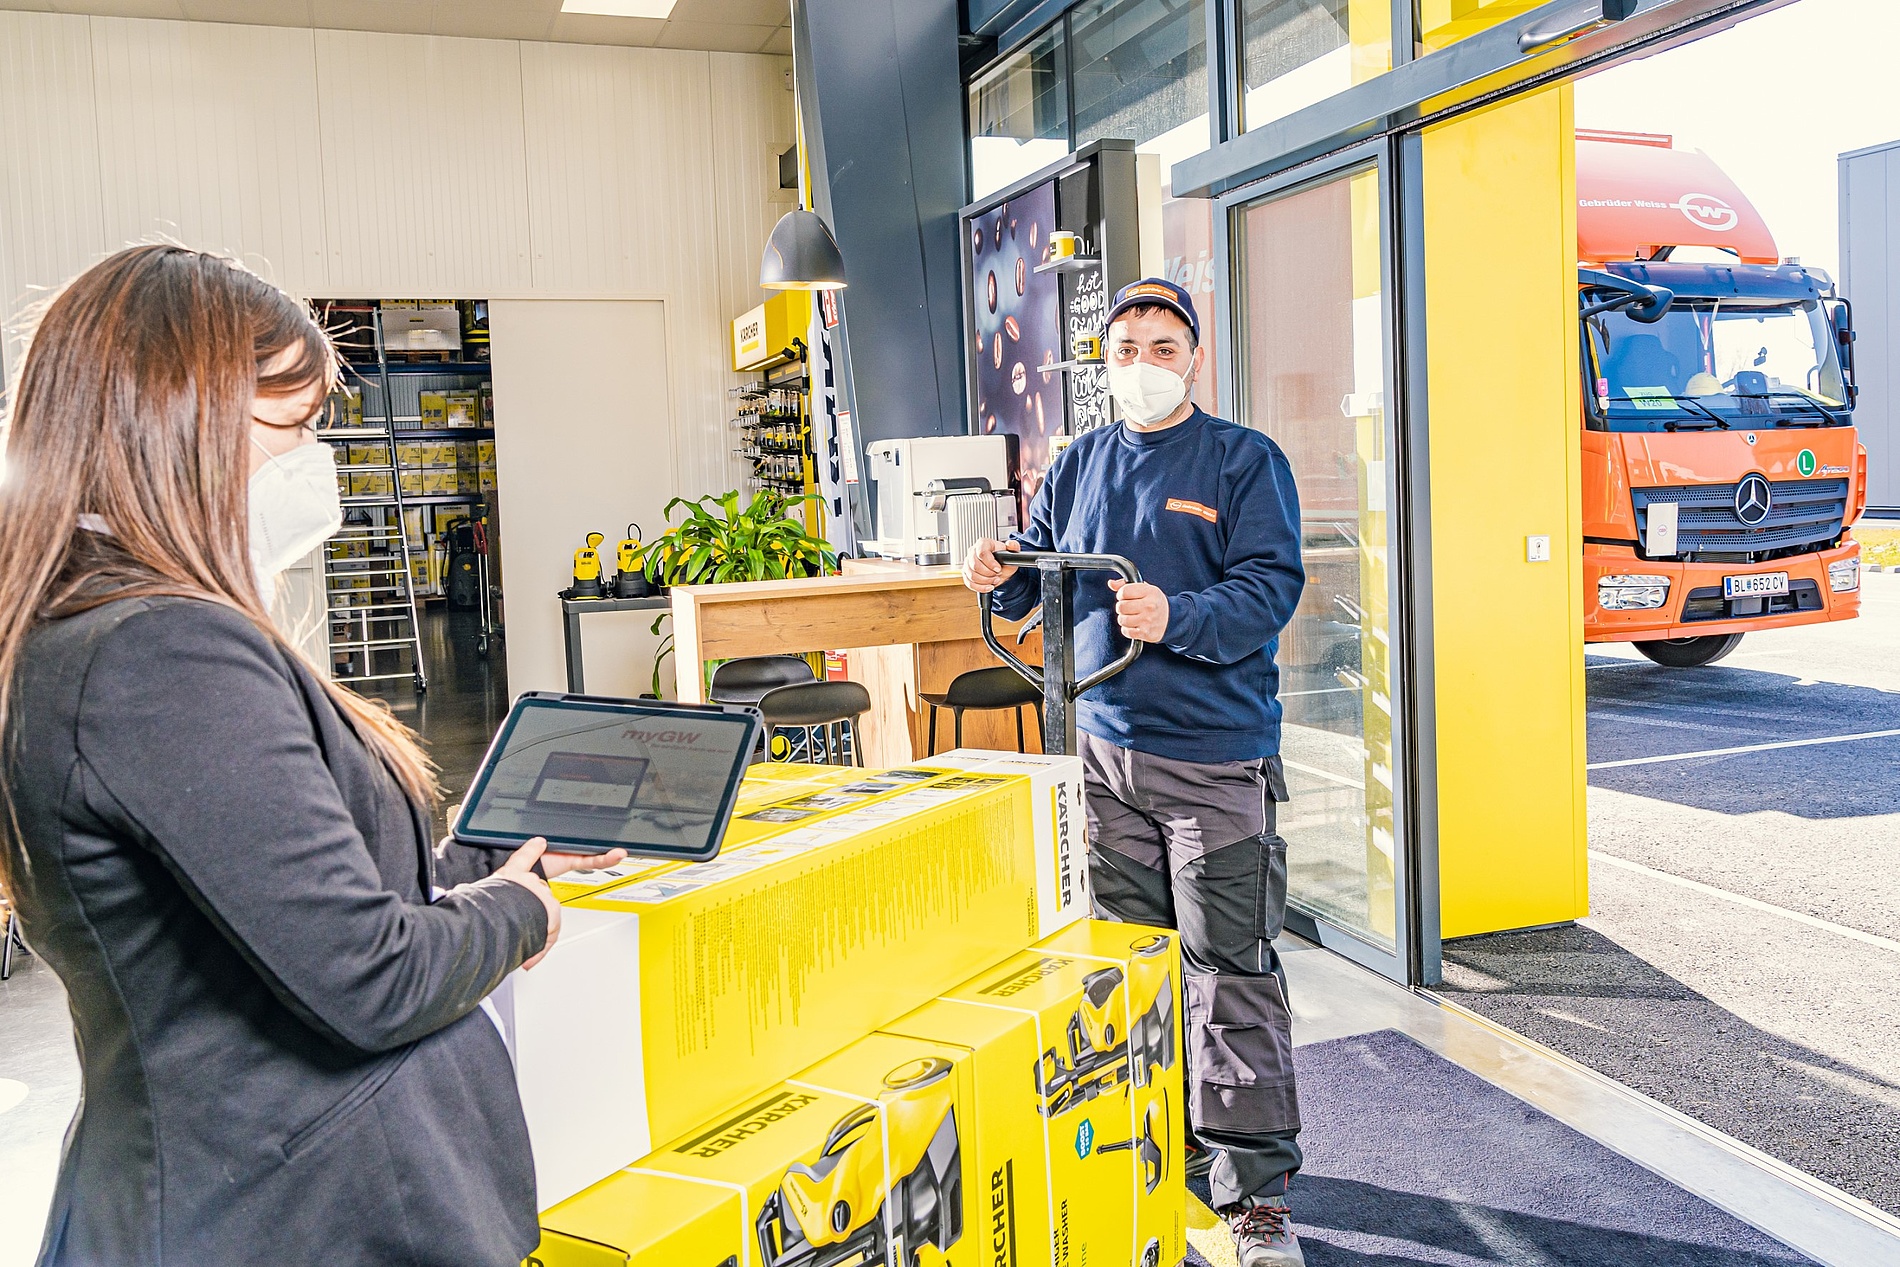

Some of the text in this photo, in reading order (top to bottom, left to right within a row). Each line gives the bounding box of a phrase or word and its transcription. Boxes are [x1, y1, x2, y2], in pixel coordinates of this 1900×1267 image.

[1578, 199, 1668, 209] Gebrüder Weiss
[1076, 270, 1103, 294] hot
[1802, 455, 1811, 471] L
[1734, 576, 1785, 593] BL 652 CV
[620, 729, 703, 744] myGW
[1057, 781, 1072, 908] KÄRCHER
[991, 958, 1074, 997] KÄRCHER
[690, 1094, 819, 1158] KÄRCHER
[1060, 1198, 1069, 1262] WASHER
